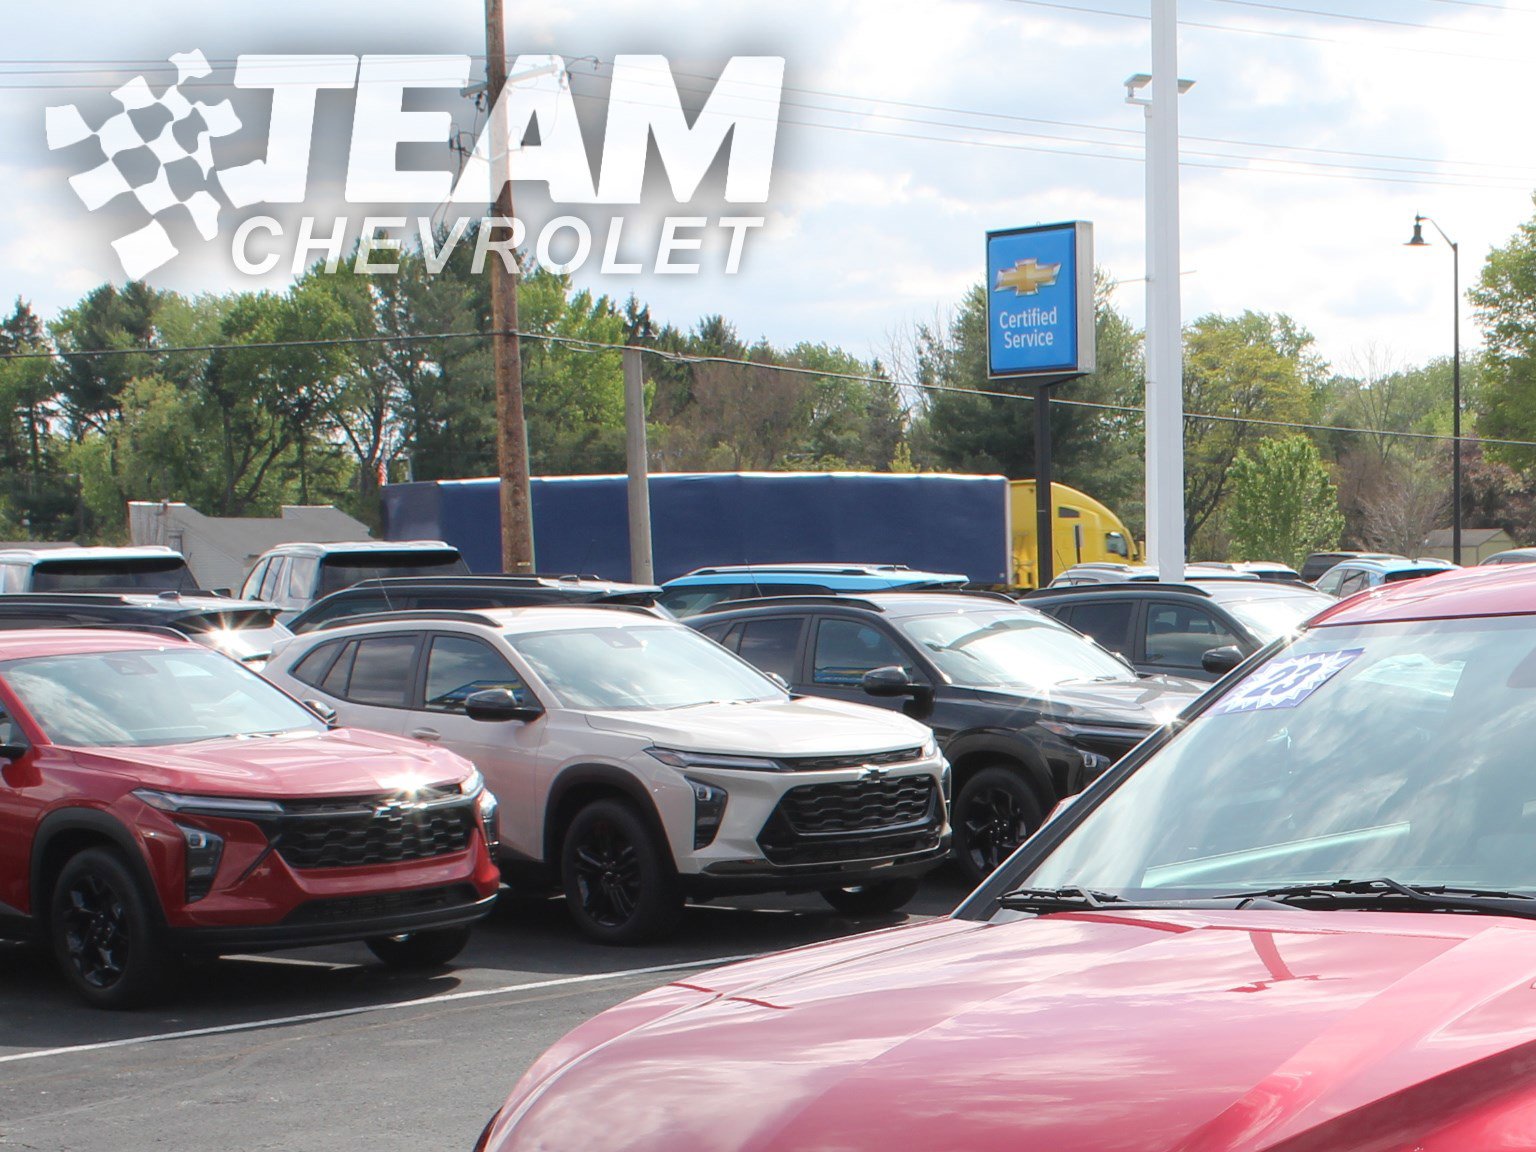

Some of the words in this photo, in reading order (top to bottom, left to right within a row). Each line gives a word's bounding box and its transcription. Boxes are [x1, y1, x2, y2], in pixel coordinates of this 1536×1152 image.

[999, 306, 1058, 330] Certified
[1004, 329, 1054, 349] Service
[1241, 662, 1323, 698] 23
